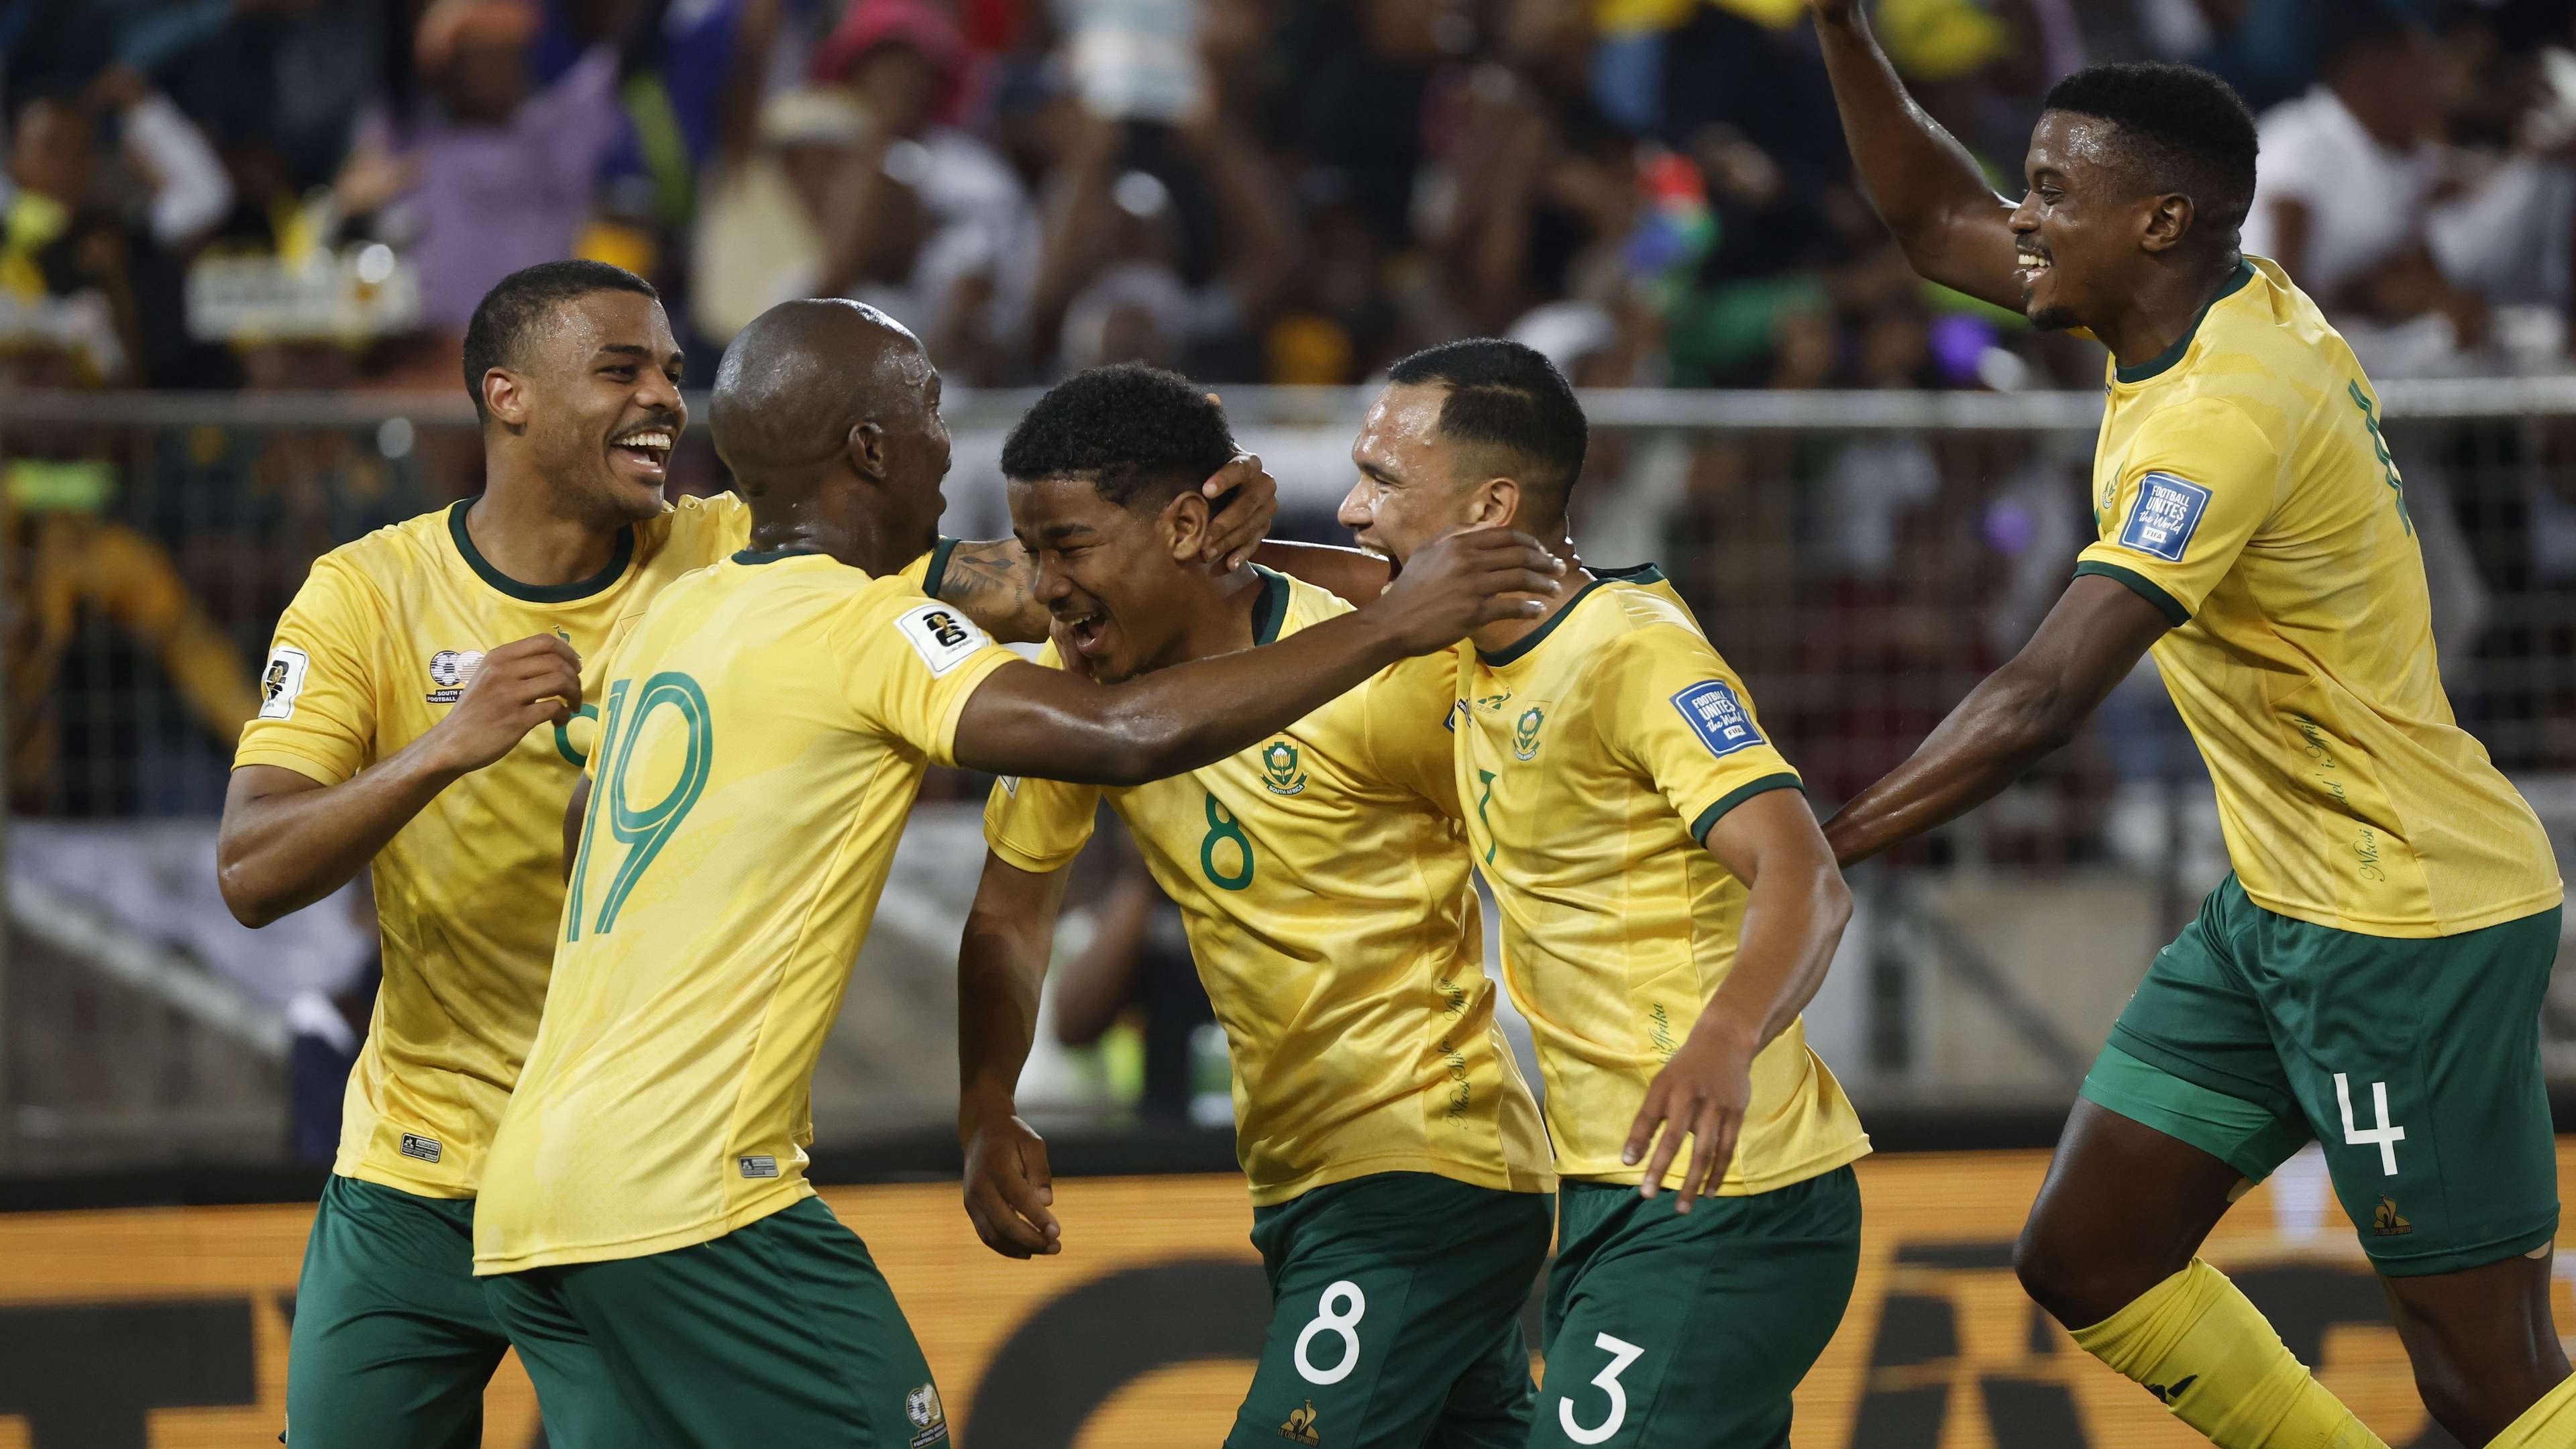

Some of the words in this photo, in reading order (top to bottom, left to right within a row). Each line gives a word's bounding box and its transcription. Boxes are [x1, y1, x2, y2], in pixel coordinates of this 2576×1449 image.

[2151, 486, 2190, 507] FOOTBALL
[2146, 496, 2187, 521] UNITES
[2139, 510, 2154, 523] the
[2154, 513, 2184, 535] World
[2147, 529, 2162, 540] FIFA
[1691, 690, 1727, 709] FOOTBALL
[1698, 700, 1735, 721] UNITES
[1706, 718, 1723, 733] the
[1720, 711, 1744, 726] World
[1728, 727, 1742, 736] FIFA
[1269, 785, 1286, 794] SOUTH
[1287, 784, 1303, 794] AFRICA
[567, 672, 712, 943] 19
[1201, 791, 1254, 891] 8
[2333, 1073, 2406, 1176] 4
[1294, 1280, 1366, 1385] 8
[1559, 1332, 1645, 1445] 3
